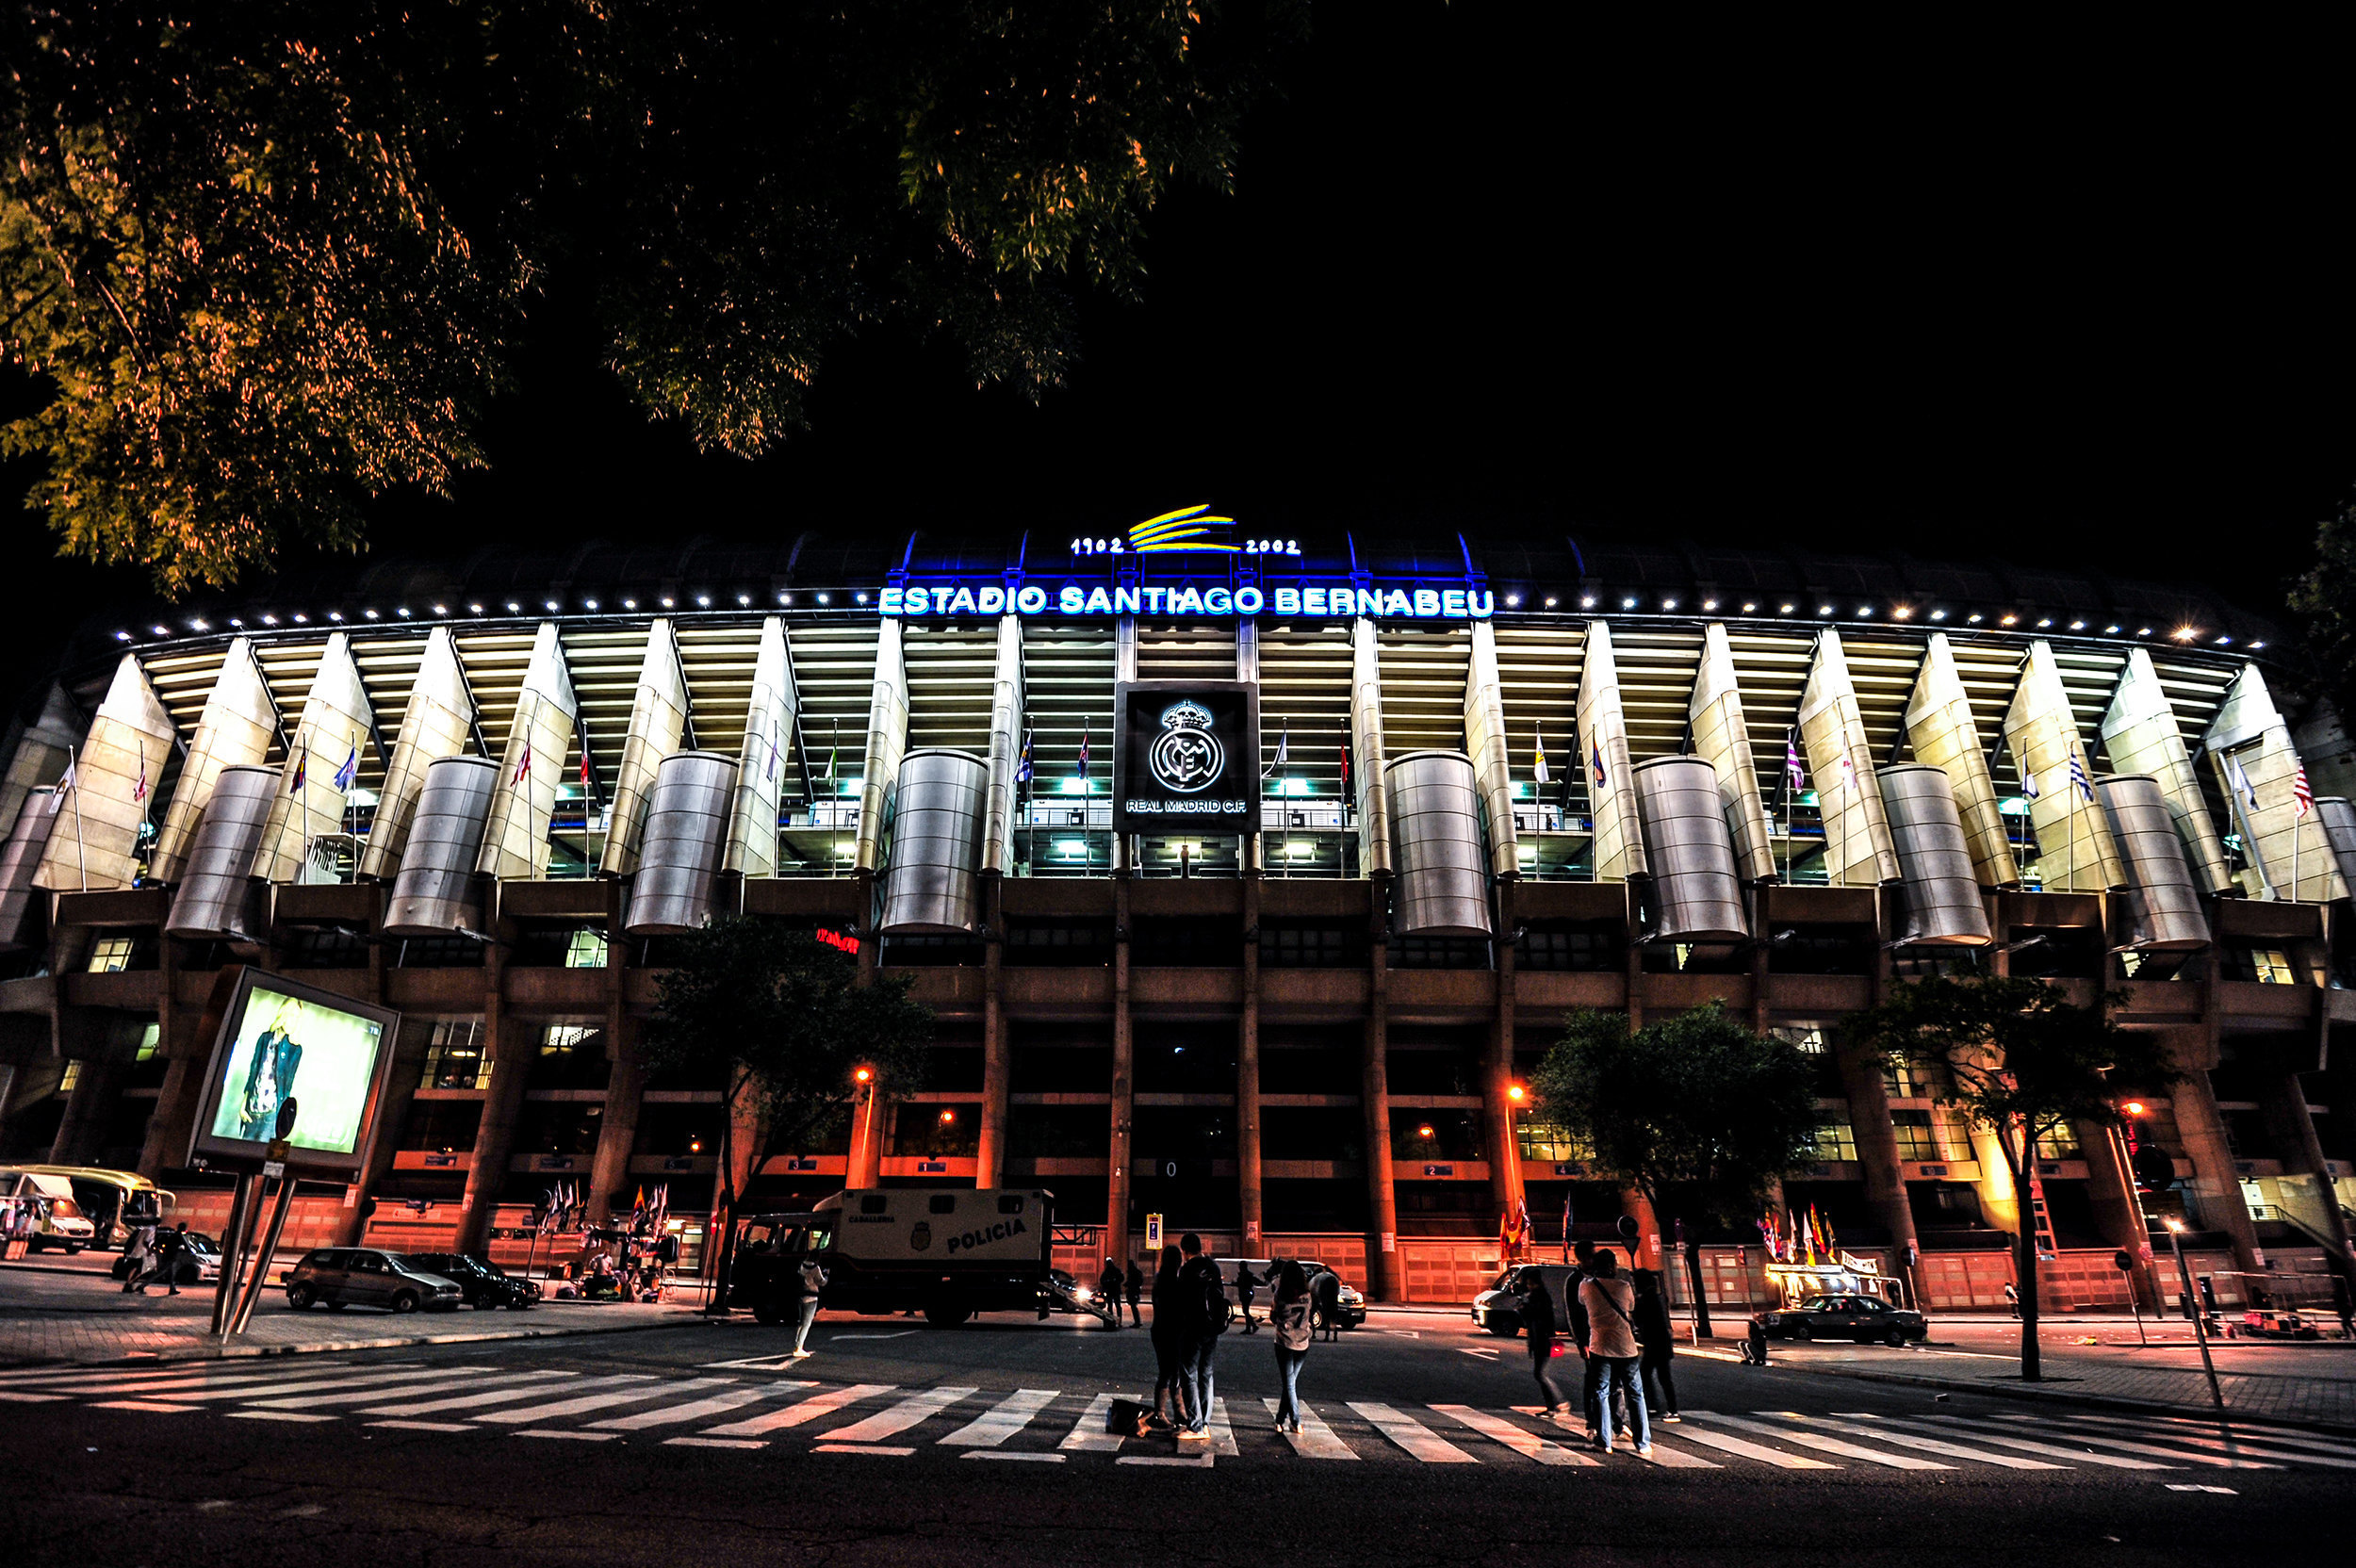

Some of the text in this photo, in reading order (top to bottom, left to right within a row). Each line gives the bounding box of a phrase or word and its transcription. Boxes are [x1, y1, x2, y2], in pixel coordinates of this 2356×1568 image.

[1071, 537, 1301, 555] 1902 2002
[878, 586, 1495, 617] ESTADIO SANTIAGO BERNABEU
[1126, 800, 1247, 812] REAL MADRID C.F.
[792, 1160, 799, 1170] 3
[922, 1163, 927, 1172] 1
[1167, 1162, 1176, 1177] 0
[1429, 1167, 1436, 1176] 2
[1560, 1167, 1566, 1175] 4
[947, 1218, 1027, 1254] POLICIA
[1291, 1306, 1305, 1329] 7
